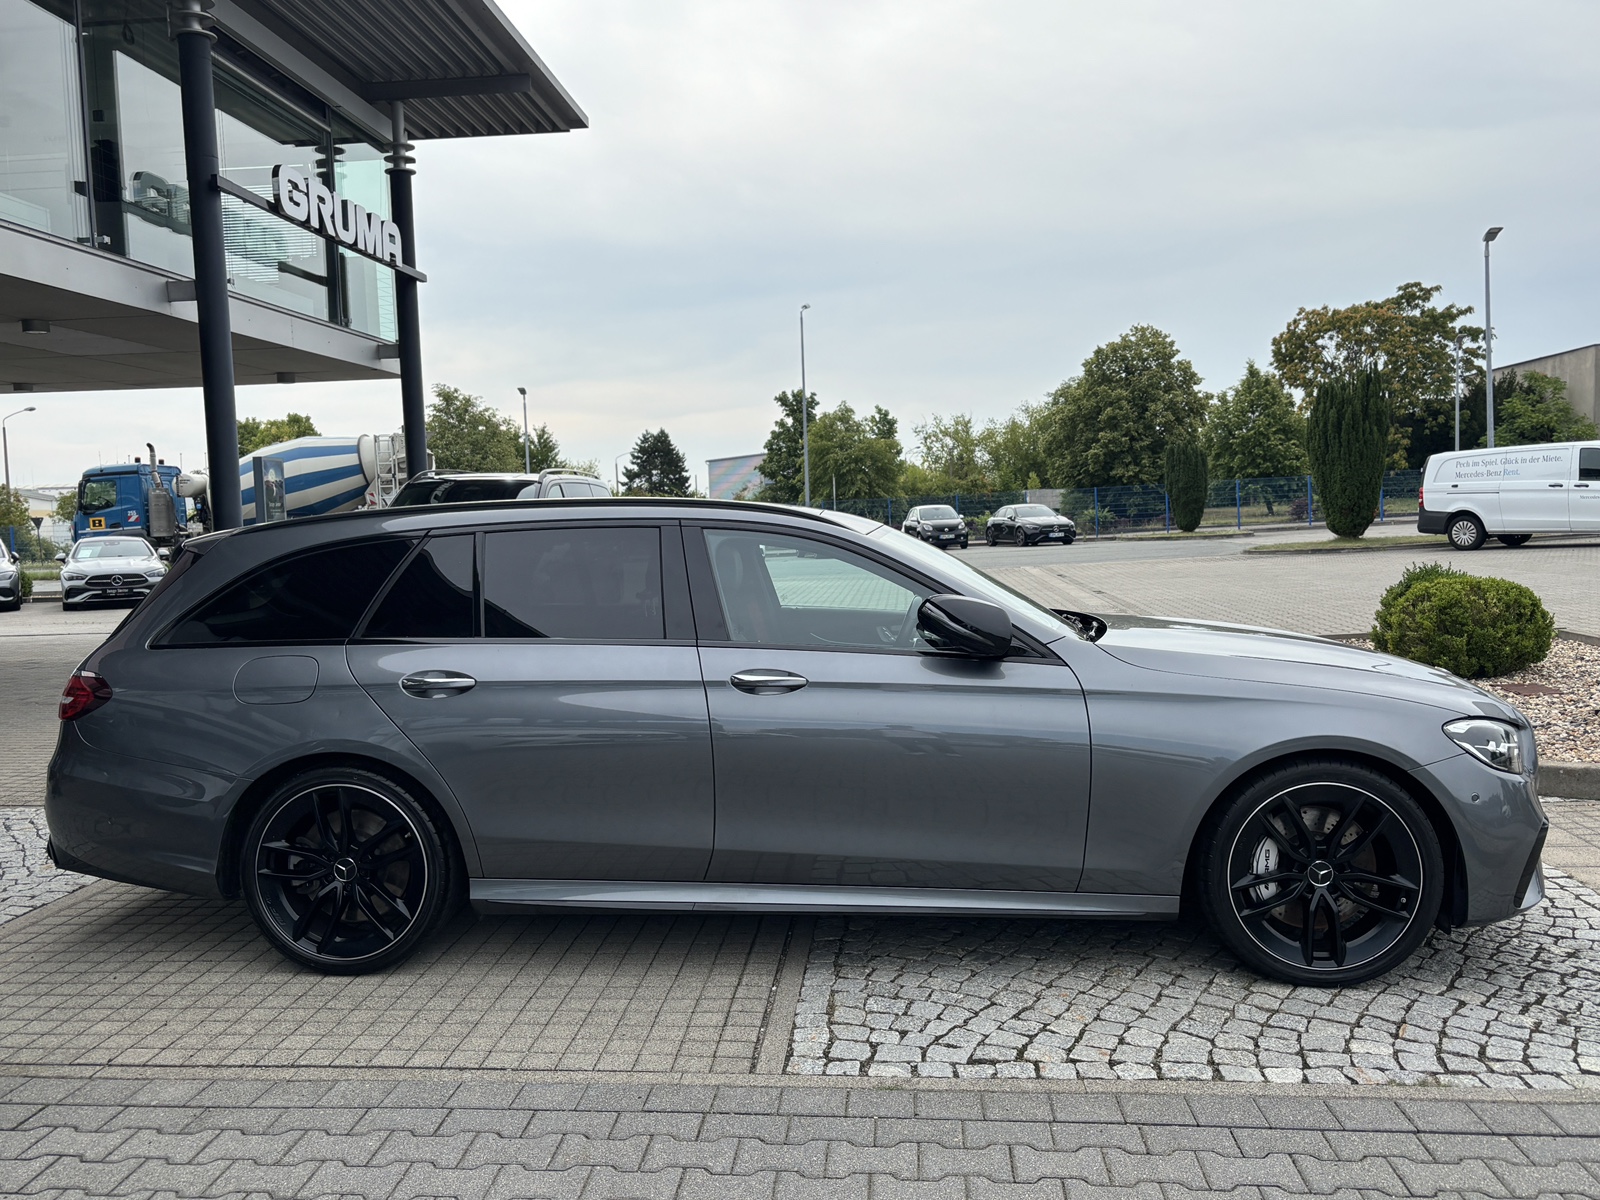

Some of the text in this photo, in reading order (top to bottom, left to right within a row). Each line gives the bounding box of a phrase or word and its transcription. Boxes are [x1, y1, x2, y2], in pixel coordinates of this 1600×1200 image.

[272, 163, 403, 267] GRUMA
[1455, 460, 1470, 468] Pech
[1481, 458, 1498, 468] Spiel.
[1500, 457, 1519, 465] Glück
[1541, 454, 1563, 463] Miete.
[1455, 468, 1520, 479] Mercedes-Benz Rent.
